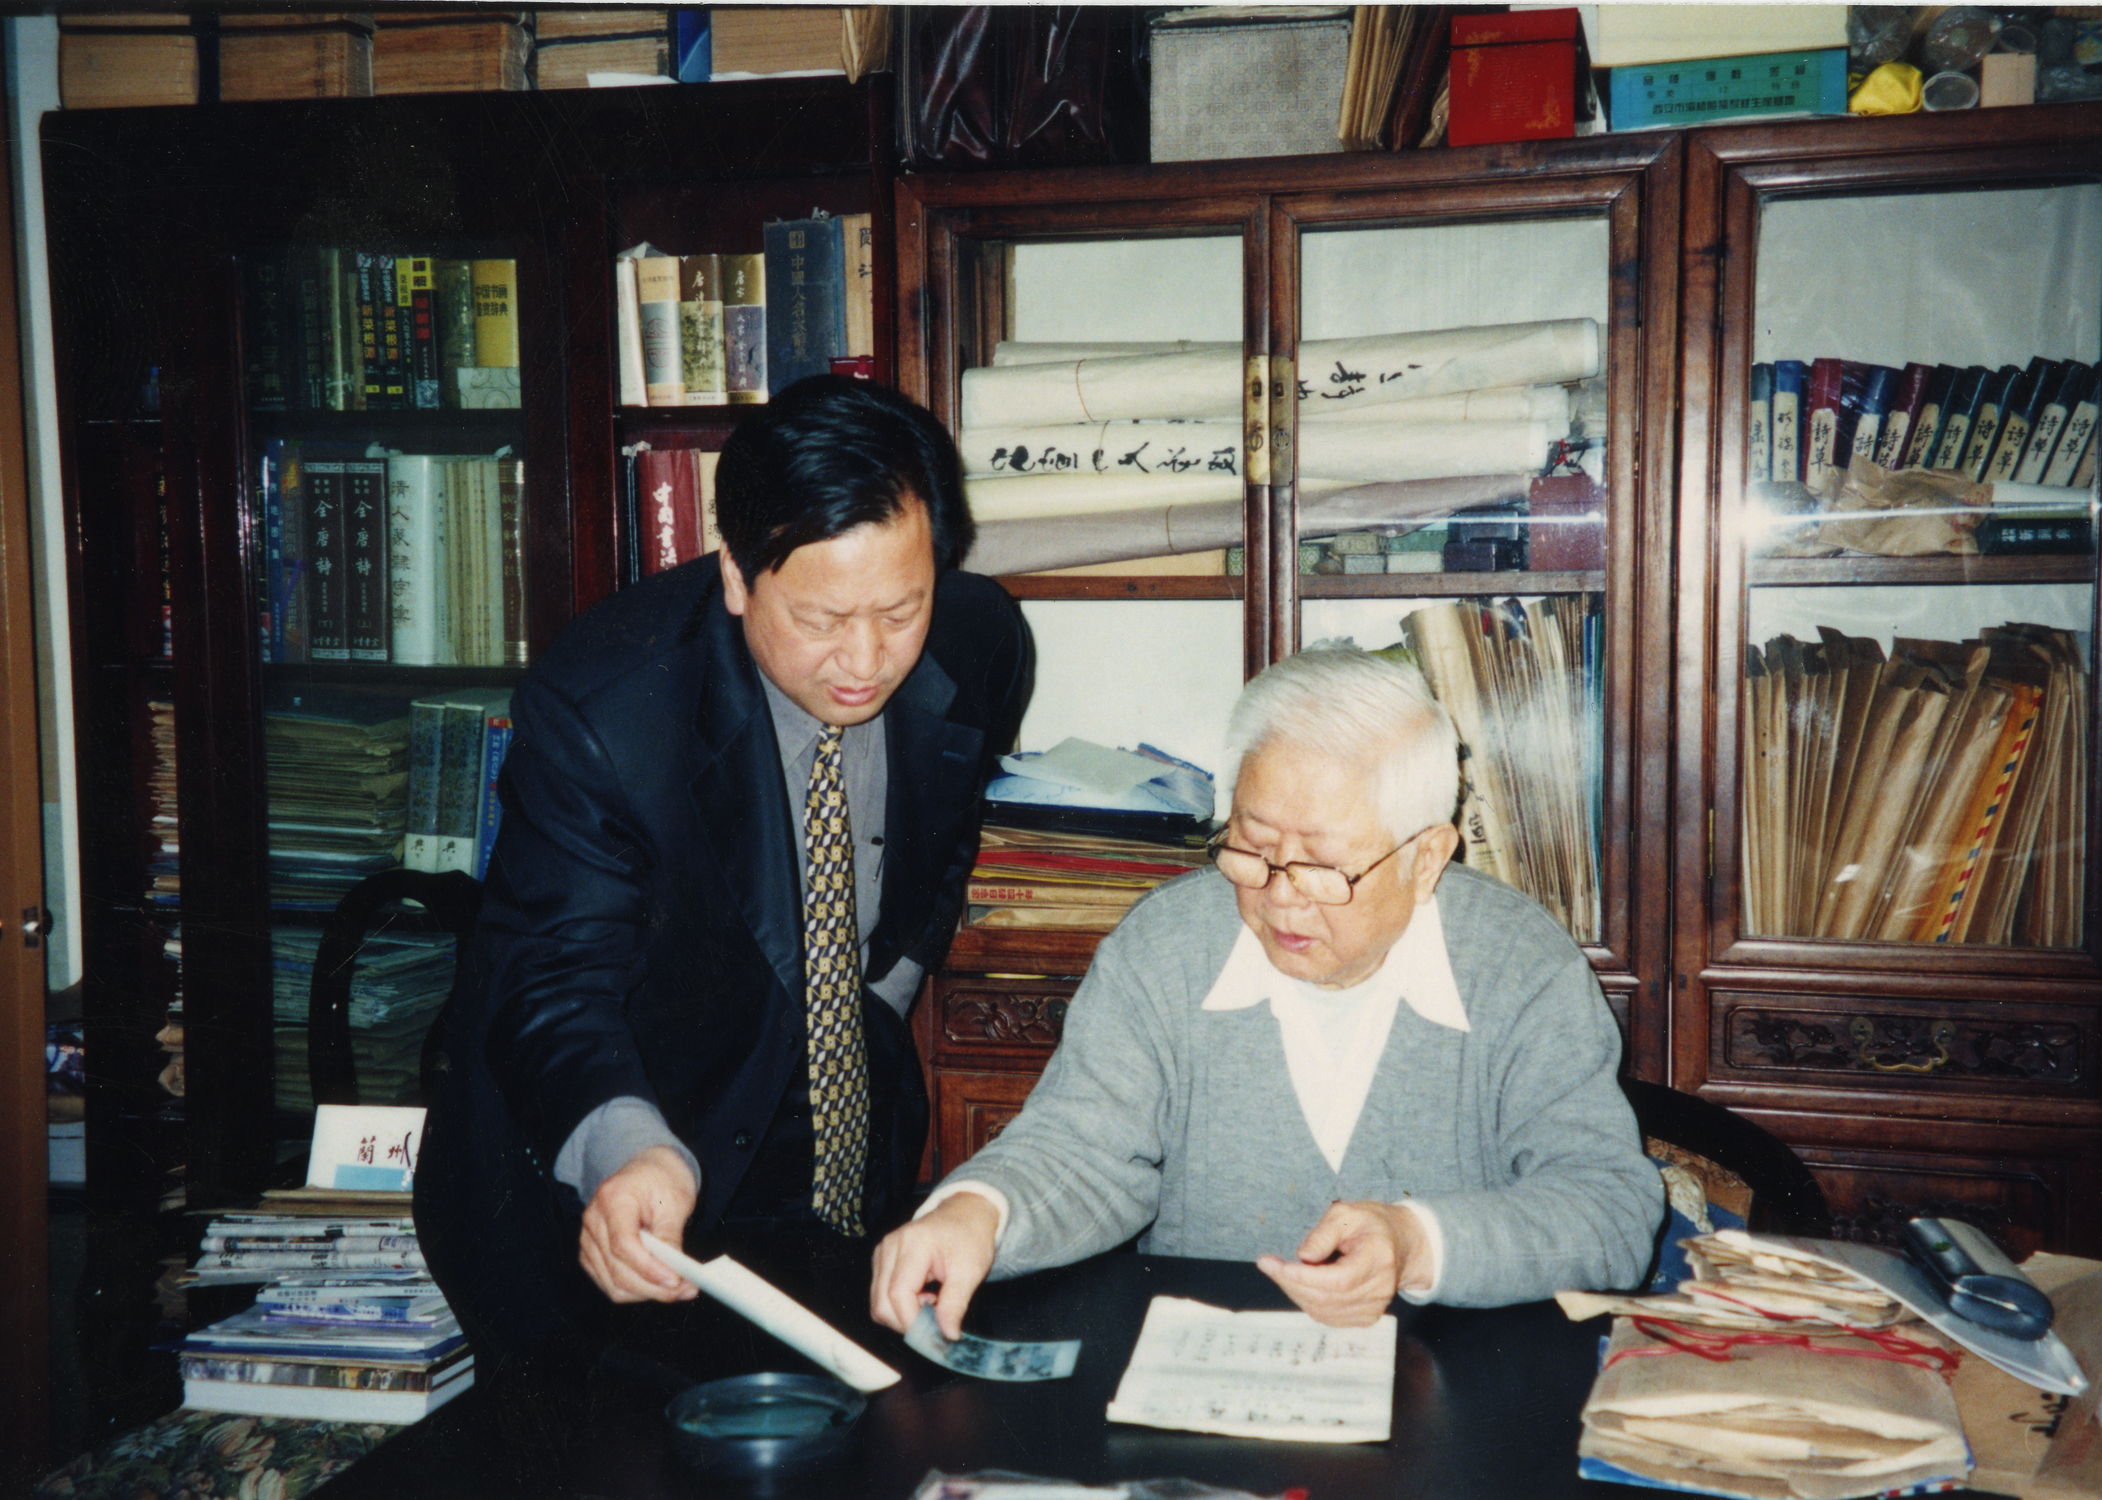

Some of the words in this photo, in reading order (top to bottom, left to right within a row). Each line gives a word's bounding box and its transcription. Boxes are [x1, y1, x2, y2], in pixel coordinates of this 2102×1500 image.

[475, 283, 508, 299] 中国书画
[313, 499, 334, 577] 全唐詩
[353, 499, 373, 577] 全唐詩
